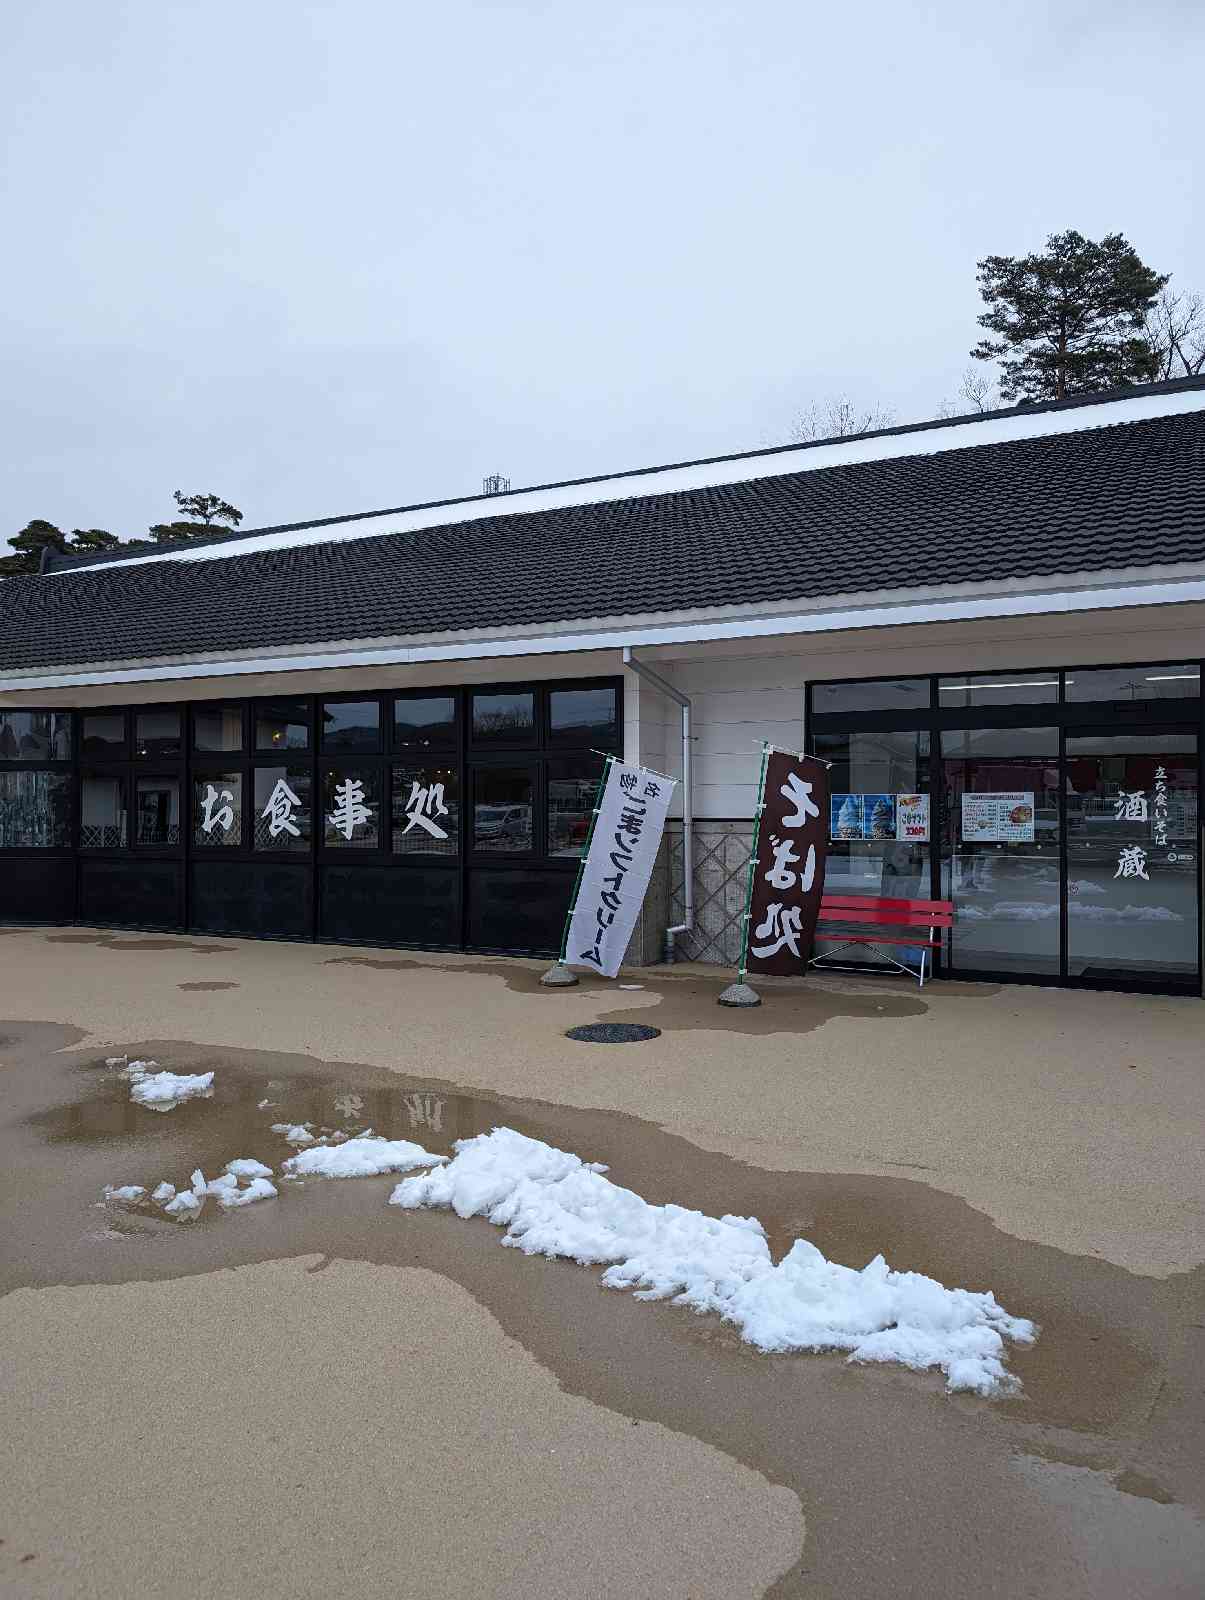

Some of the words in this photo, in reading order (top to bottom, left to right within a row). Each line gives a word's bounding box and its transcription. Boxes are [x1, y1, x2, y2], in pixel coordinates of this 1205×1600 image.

[200, 778, 450, 840] お食事処
[1113, 790, 1150, 881] 酒蔵
[1153, 766, 1168, 845] 立ち食いそば
